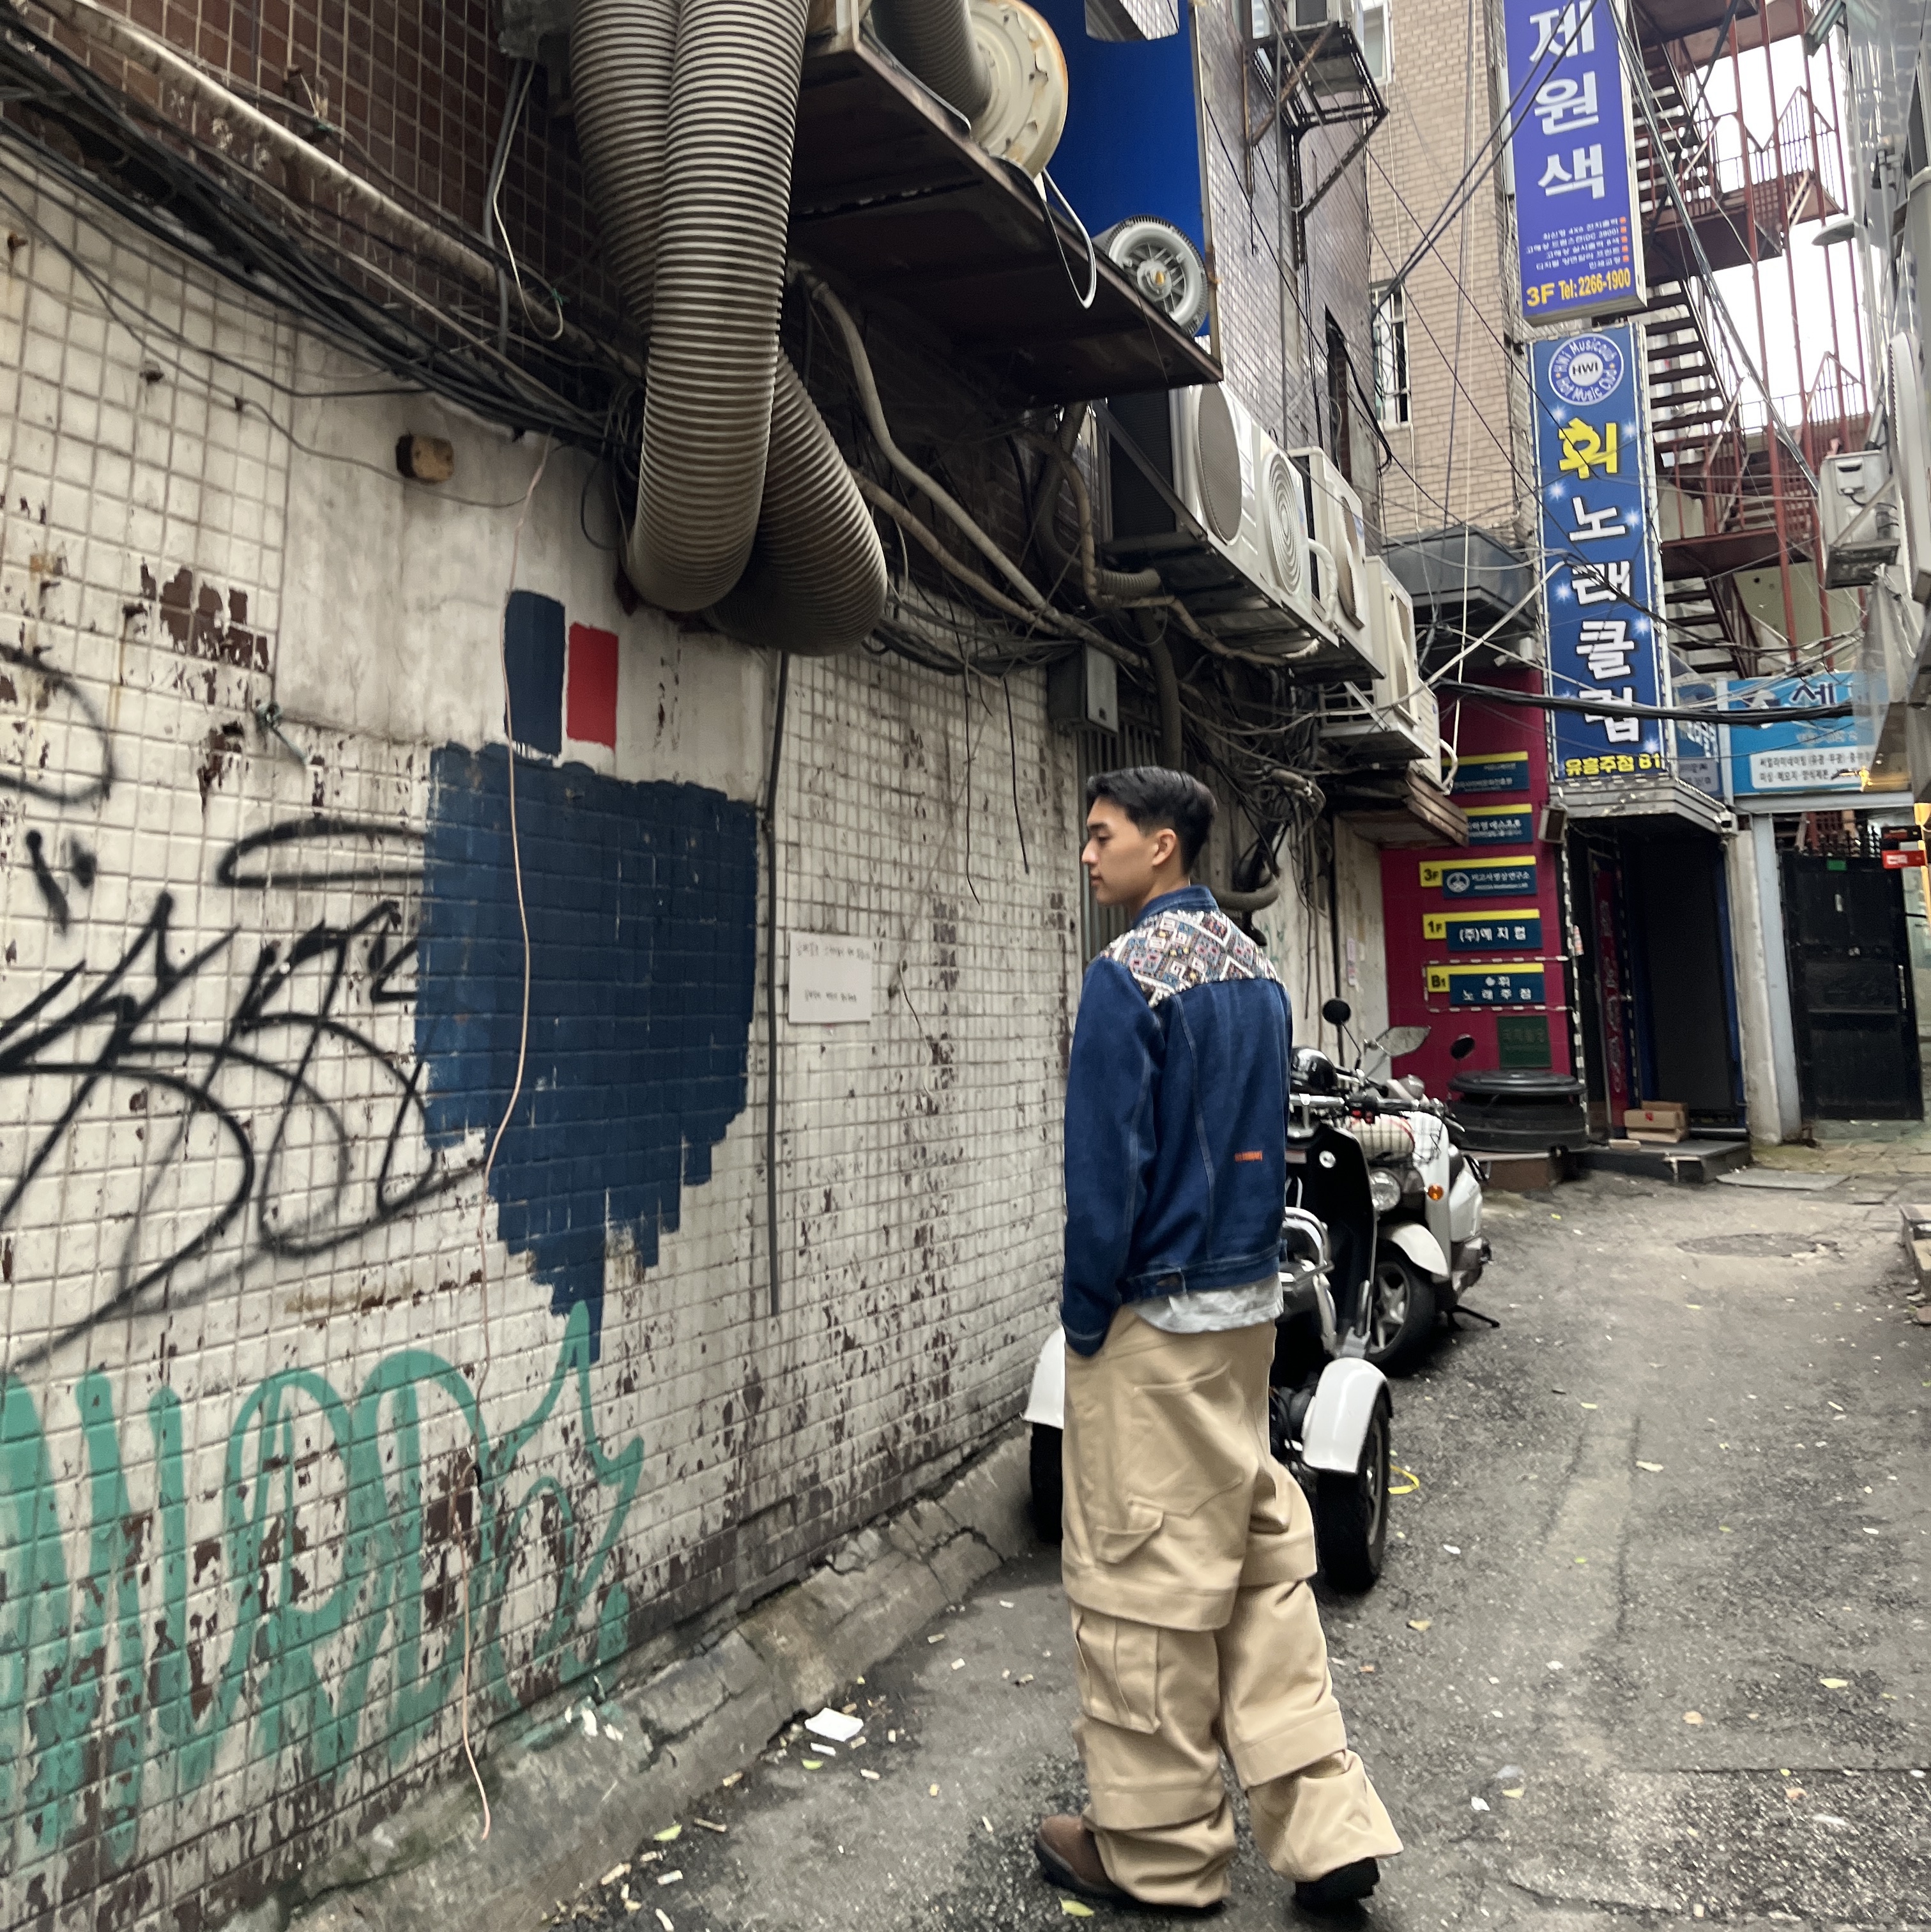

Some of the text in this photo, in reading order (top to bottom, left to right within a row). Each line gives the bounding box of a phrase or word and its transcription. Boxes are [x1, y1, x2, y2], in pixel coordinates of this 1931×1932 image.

[1527, 282, 1555, 307] 3F
[1572, 362, 1598, 376] HWI
[1566, 755, 1635, 777] 유흥주점
[1428, 921, 1442, 933] 1F
[1431, 975, 1446, 988] B1
